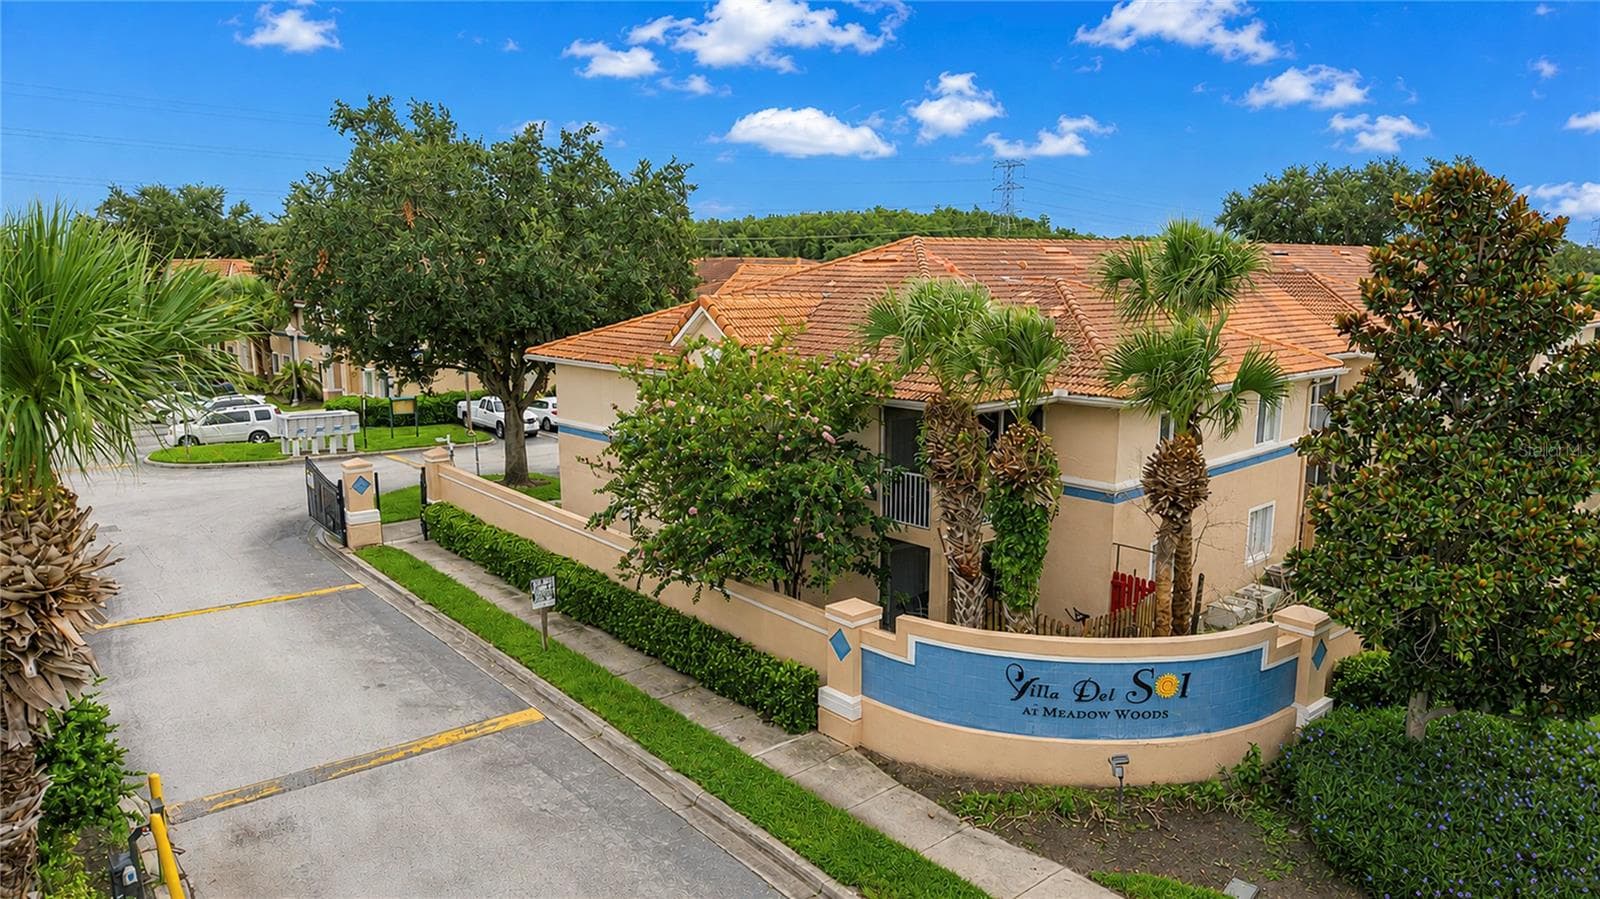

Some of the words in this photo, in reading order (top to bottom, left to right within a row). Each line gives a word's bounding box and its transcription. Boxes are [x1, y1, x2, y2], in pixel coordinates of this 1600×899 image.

[1005, 662, 1060, 702] Villa
[1072, 677, 1116, 703] Del
[1022, 706, 1039, 716] AT
[1042, 706, 1111, 719] MEADOW
[1114, 708, 1170, 720] WOODS
